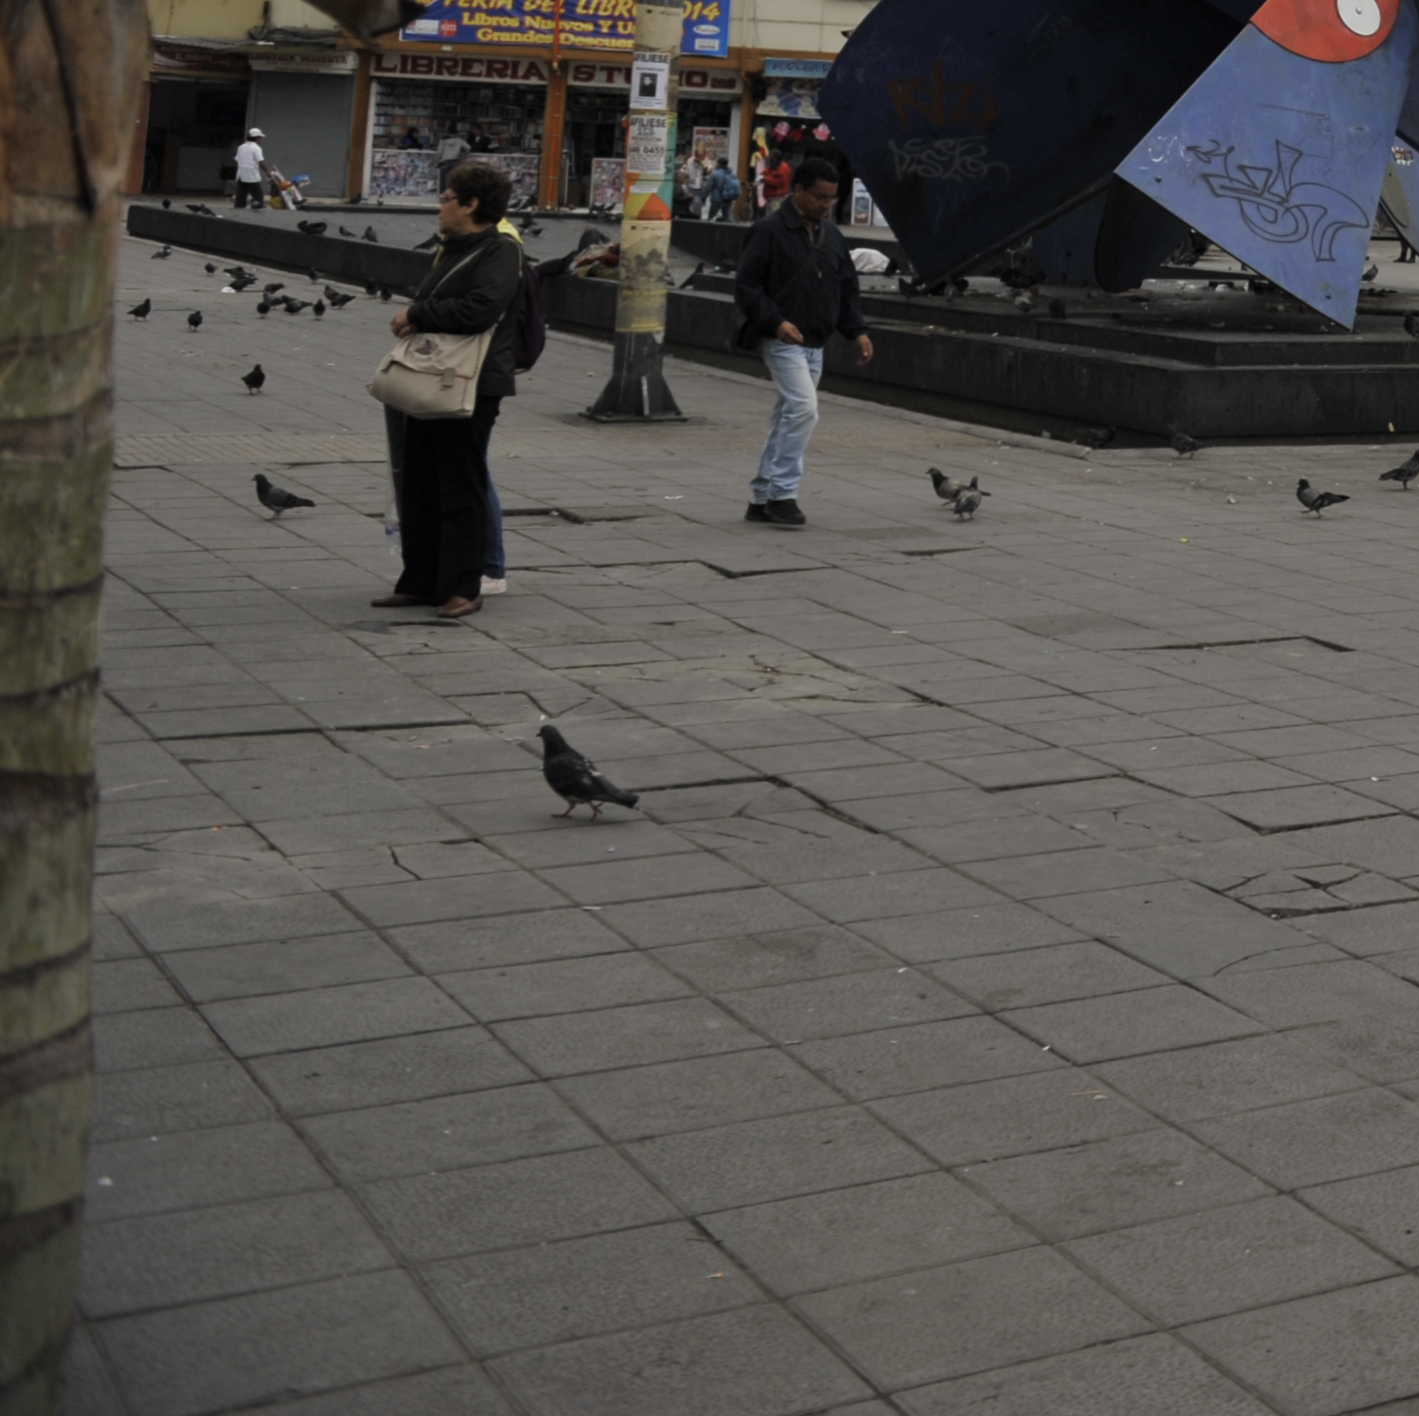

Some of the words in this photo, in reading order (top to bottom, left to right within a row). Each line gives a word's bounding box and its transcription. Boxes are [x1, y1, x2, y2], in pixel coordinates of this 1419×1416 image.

[462, 12, 520, 27] Libros
[598, 19, 613, 33] Y
[477, 28, 555, 43] Grandes
[373, 54, 547, 81] LIBRERIA
